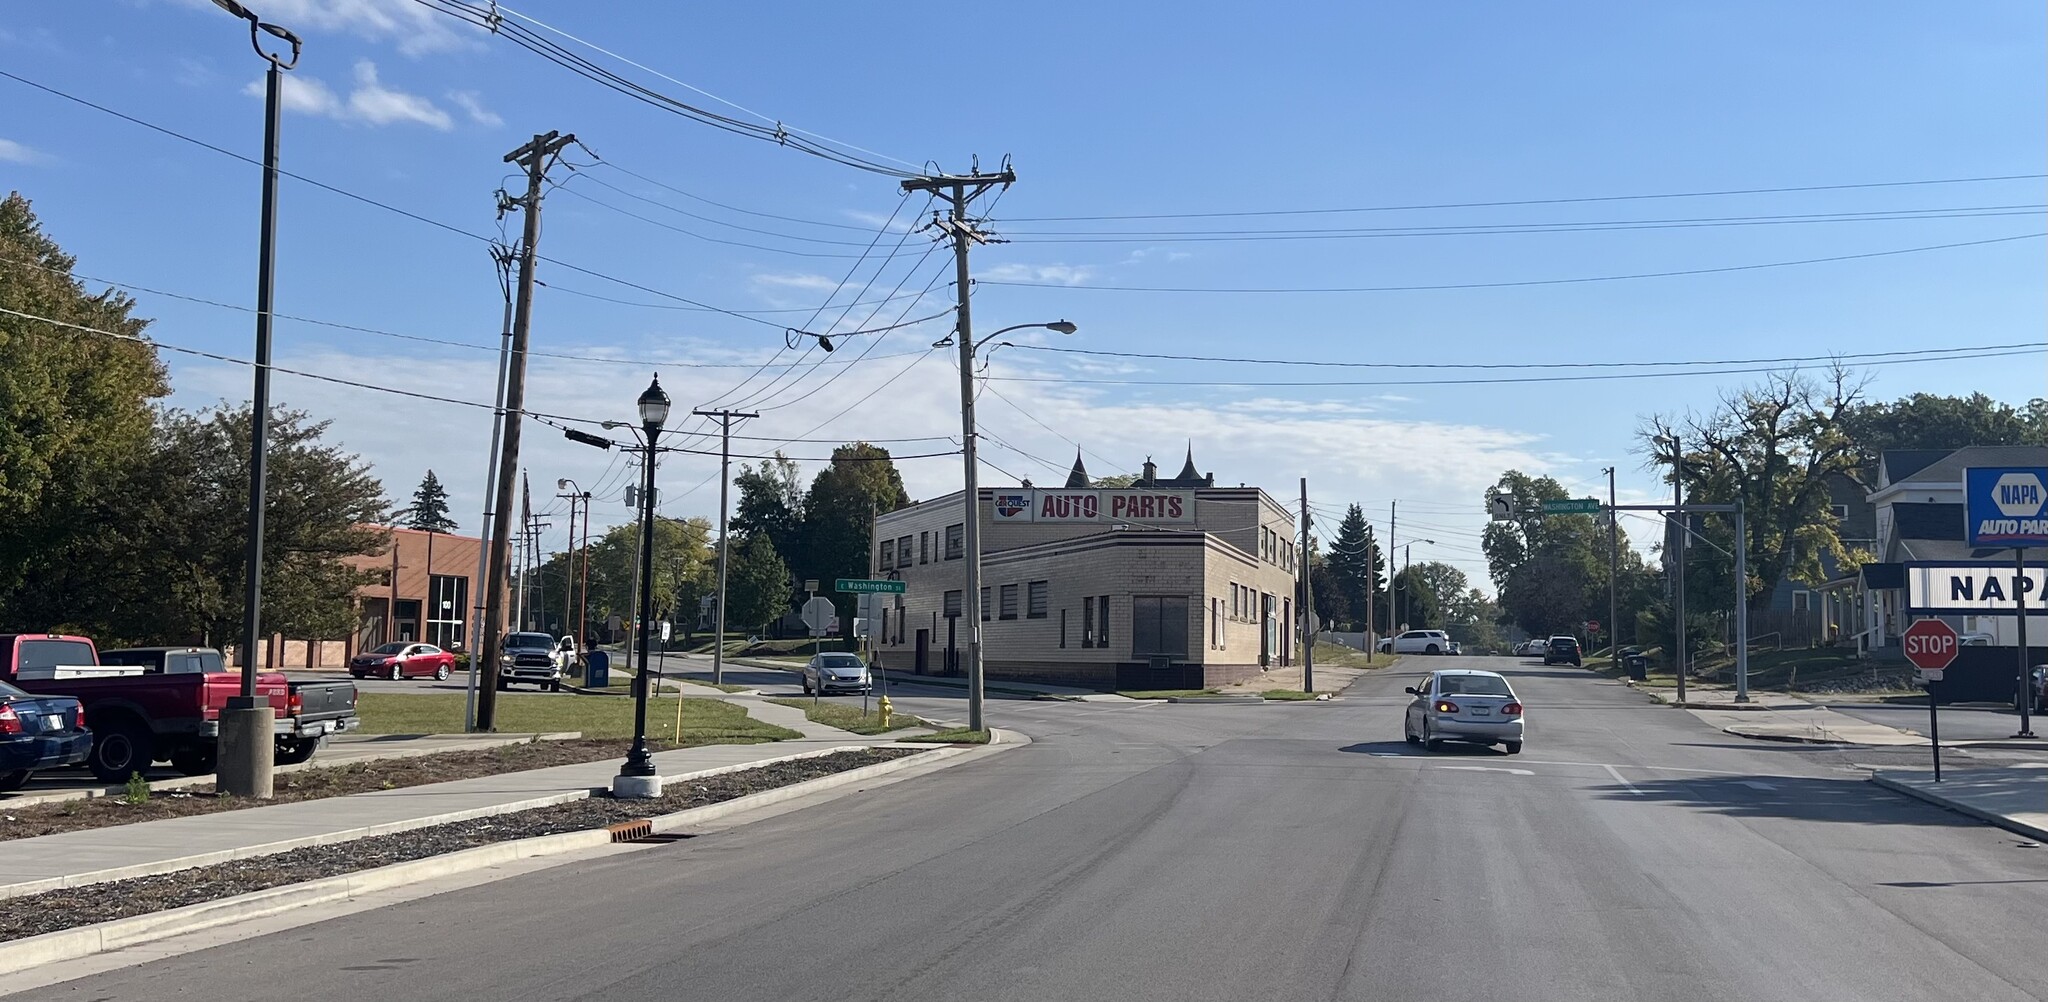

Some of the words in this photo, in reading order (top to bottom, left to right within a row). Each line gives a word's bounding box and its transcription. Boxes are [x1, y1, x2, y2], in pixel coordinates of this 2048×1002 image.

[2001, 485, 2039, 504] NAPA
[1042, 495, 1098, 518] AUTO
[1112, 495, 1183, 519] PARTS
[1543, 502, 1584, 511] WASHINGTON
[1587, 502, 1600, 510] AVE
[1978, 520, 2018, 535] AUTO
[847, 581, 892, 592] Washington
[1908, 635, 1954, 654] STOP
